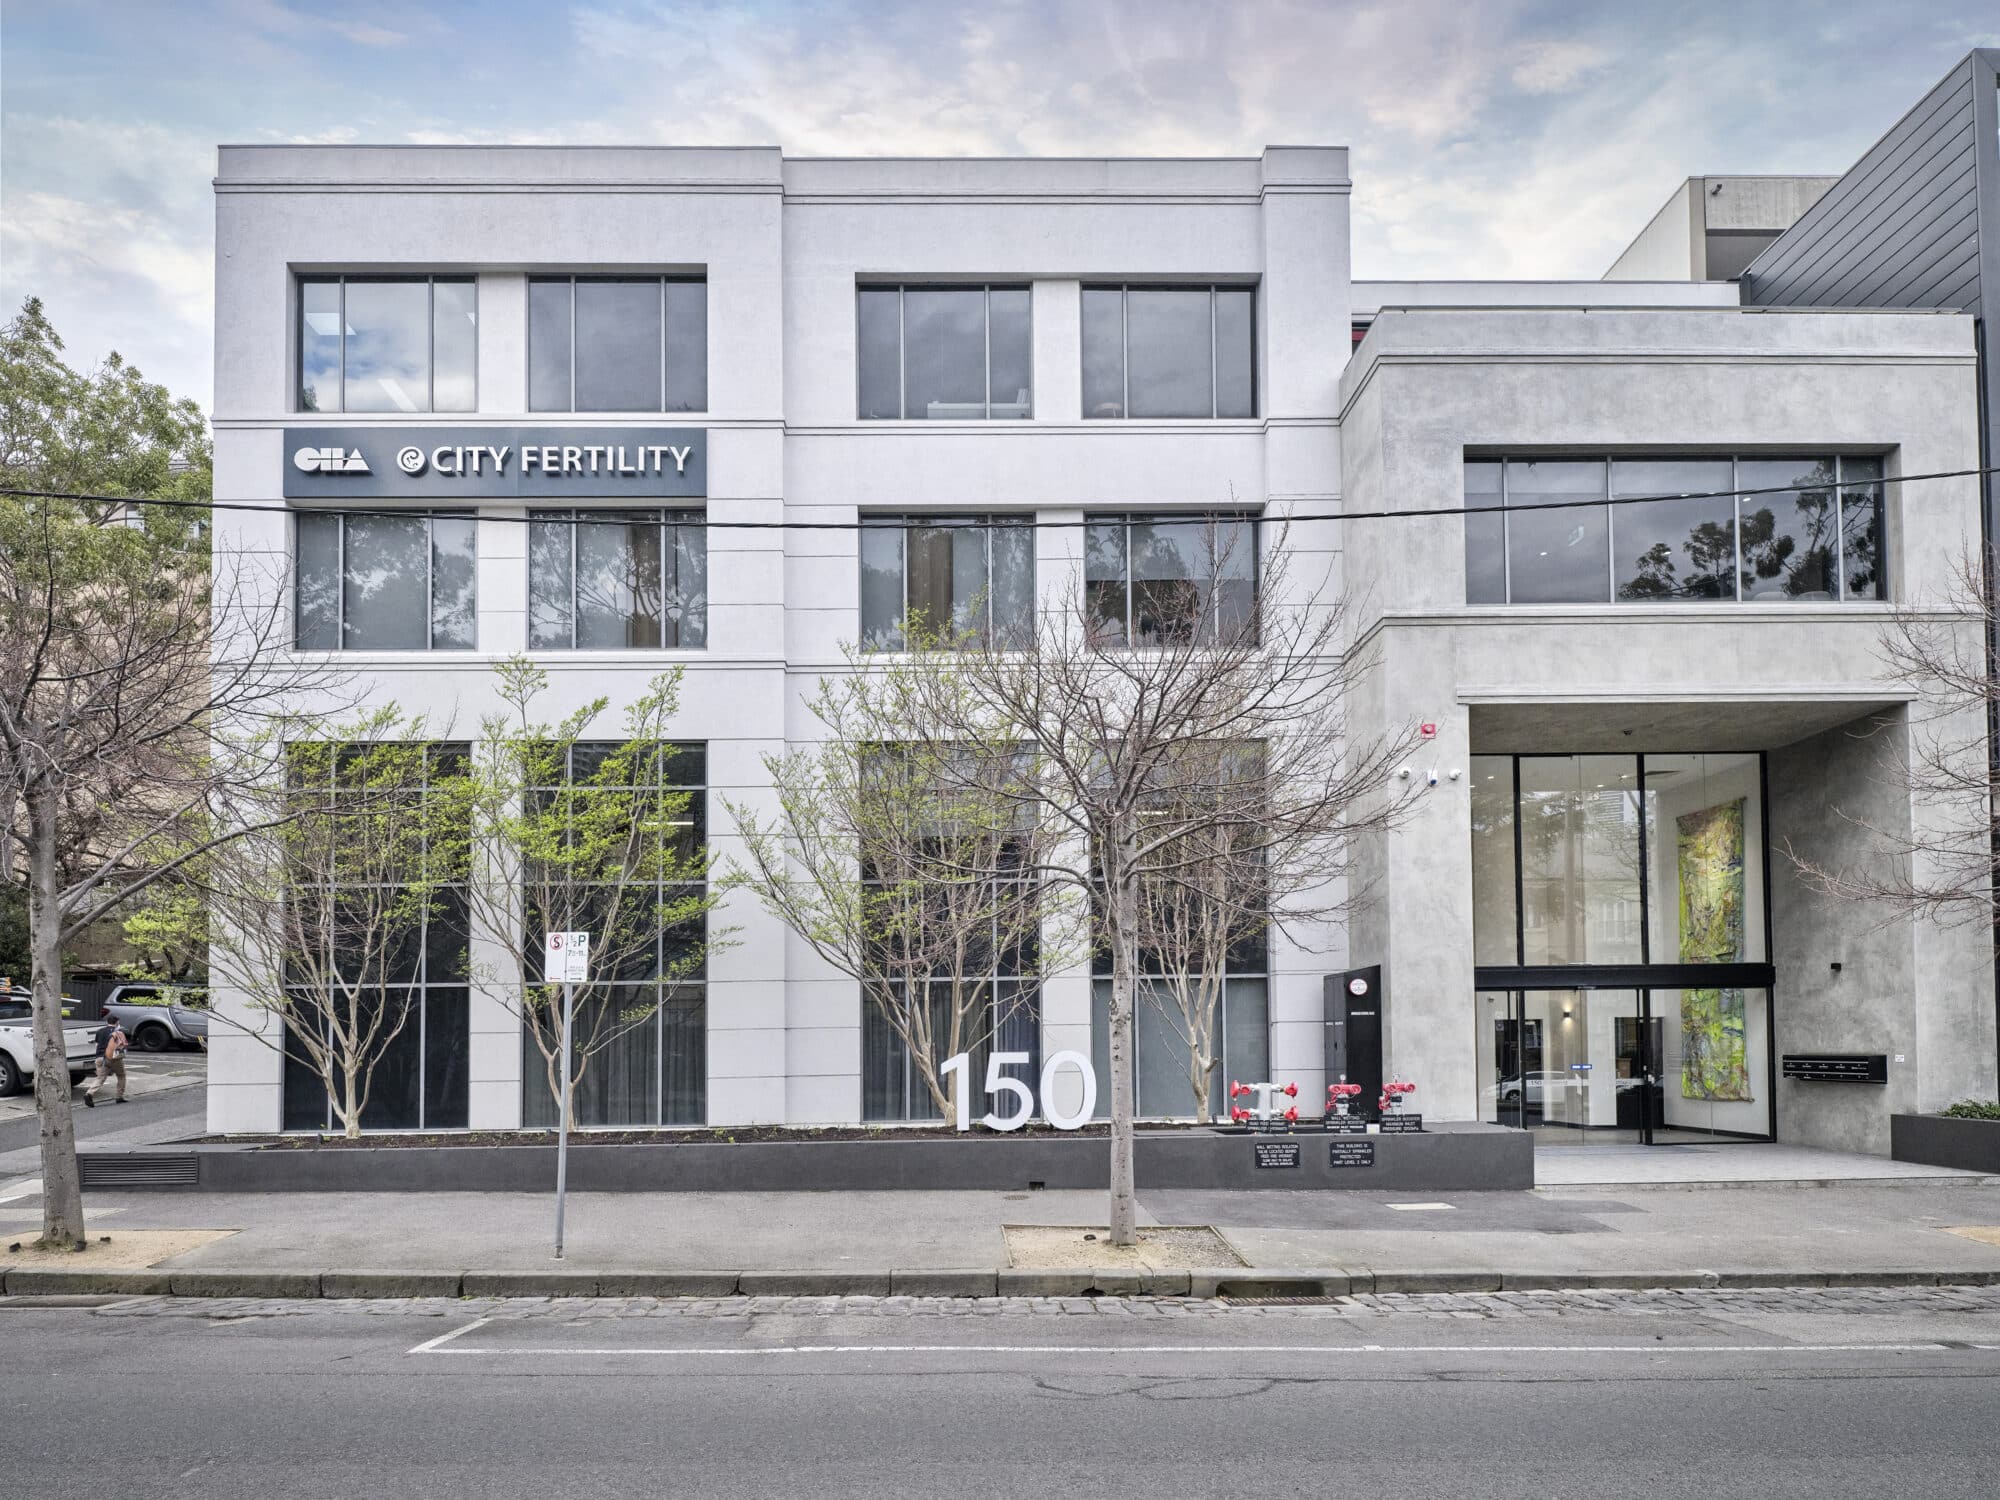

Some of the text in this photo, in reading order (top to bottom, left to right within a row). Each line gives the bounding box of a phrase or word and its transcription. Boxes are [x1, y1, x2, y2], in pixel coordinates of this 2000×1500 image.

[431, 446, 691, 472] CITY FERTILITY
[941, 1050, 1097, 1131] 150
